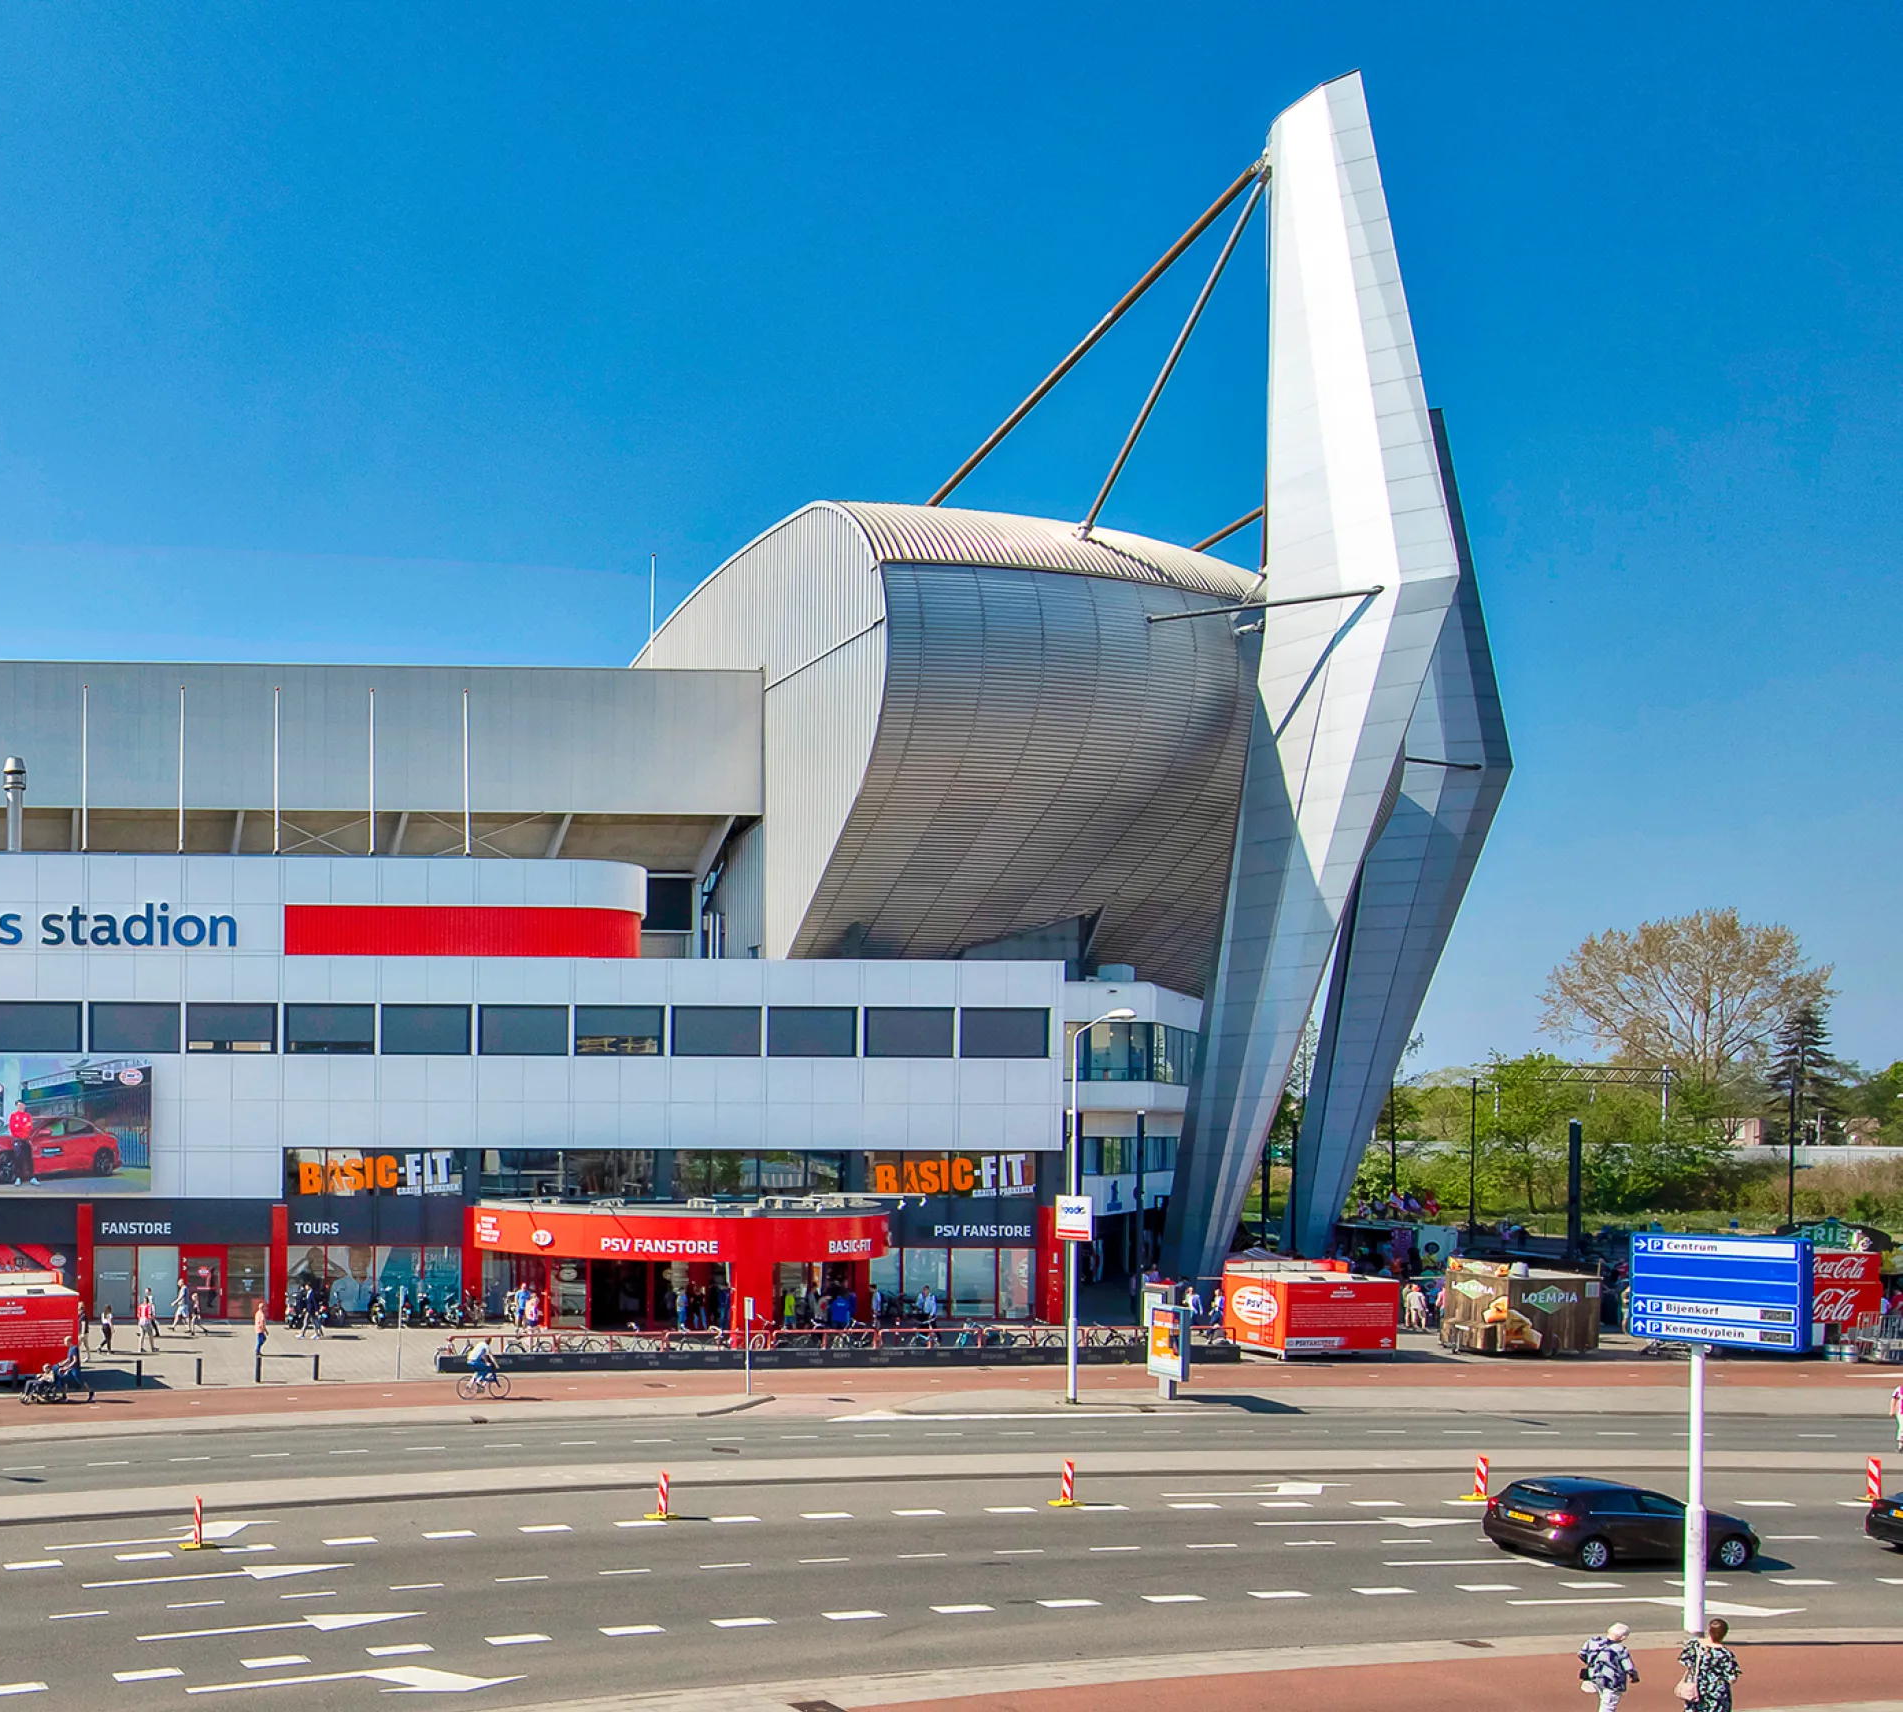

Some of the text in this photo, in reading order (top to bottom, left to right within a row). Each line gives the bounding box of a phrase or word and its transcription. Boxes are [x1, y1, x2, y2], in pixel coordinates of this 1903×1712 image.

[41, 902, 238, 947] stadion
[299, 1151, 451, 1195] BASIC-FIT
[875, 1153, 1026, 1193] BASIC-FIT
[101, 1222, 172, 1234] FANSTORE
[295, 1222, 340, 1234] TOURS
[934, 1225, 1032, 1237] PSV FANSTORE
[601, 1237, 719, 1254] PSV FANSTORE
[828, 1239, 872, 1253] BASIC-FIT
[1666, 1241, 1718, 1252] Centrum
[1521, 1291, 1578, 1303] LOEMPIA
[1665, 1302, 1719, 1315] Bijenkorf
[1664, 1323, 1745, 1339] Kennedyplein
